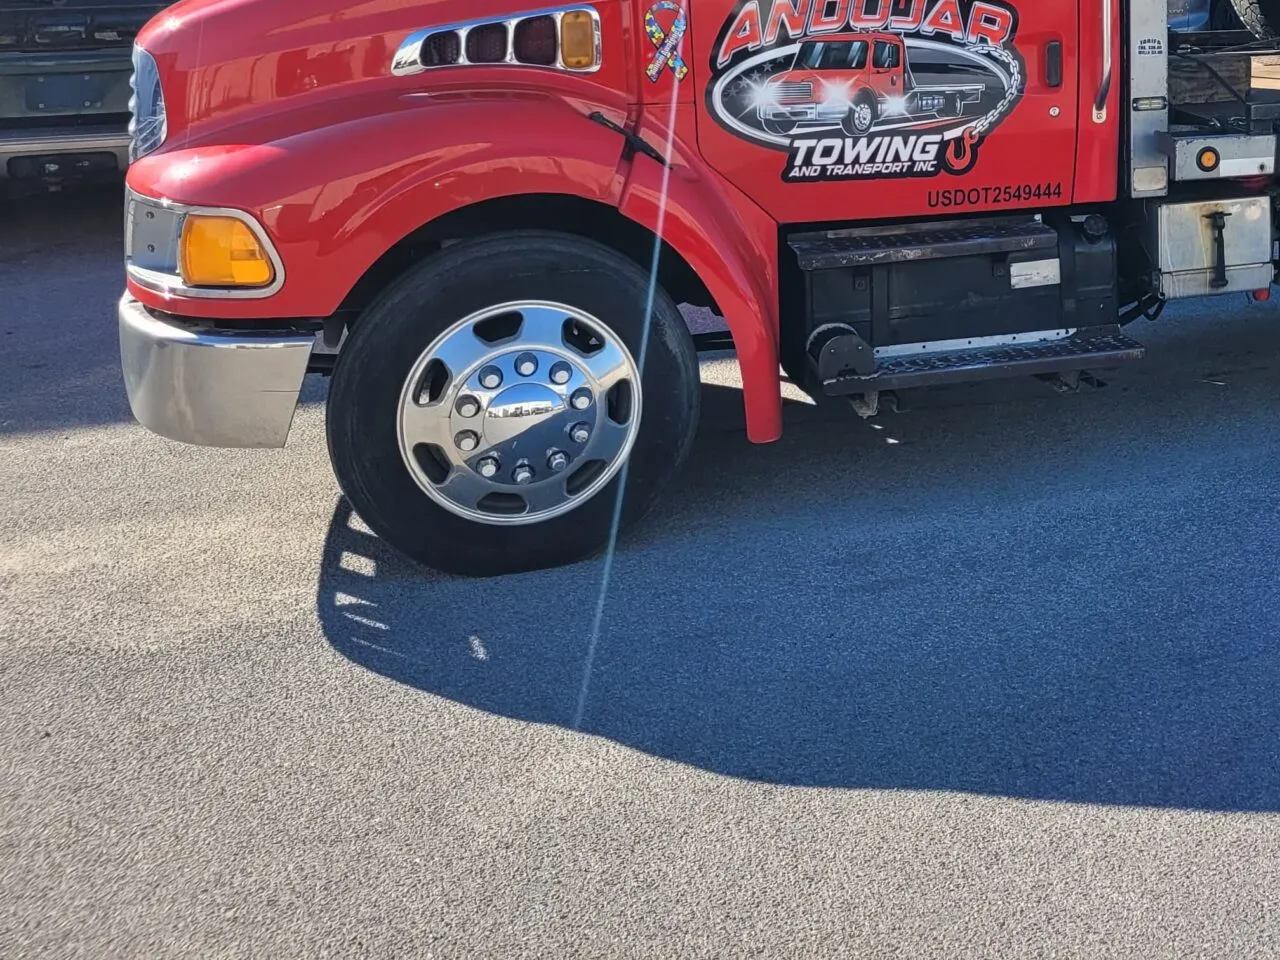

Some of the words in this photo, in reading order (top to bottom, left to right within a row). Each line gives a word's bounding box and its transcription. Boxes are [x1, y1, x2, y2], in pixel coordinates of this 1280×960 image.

[792, 135, 941, 166] TOWING
[788, 164, 822, 178] AND
[825, 161, 911, 176] TRANSPORT
[913, 159, 937, 173] INC
[928, 182, 1063, 208] USDOT2549444
